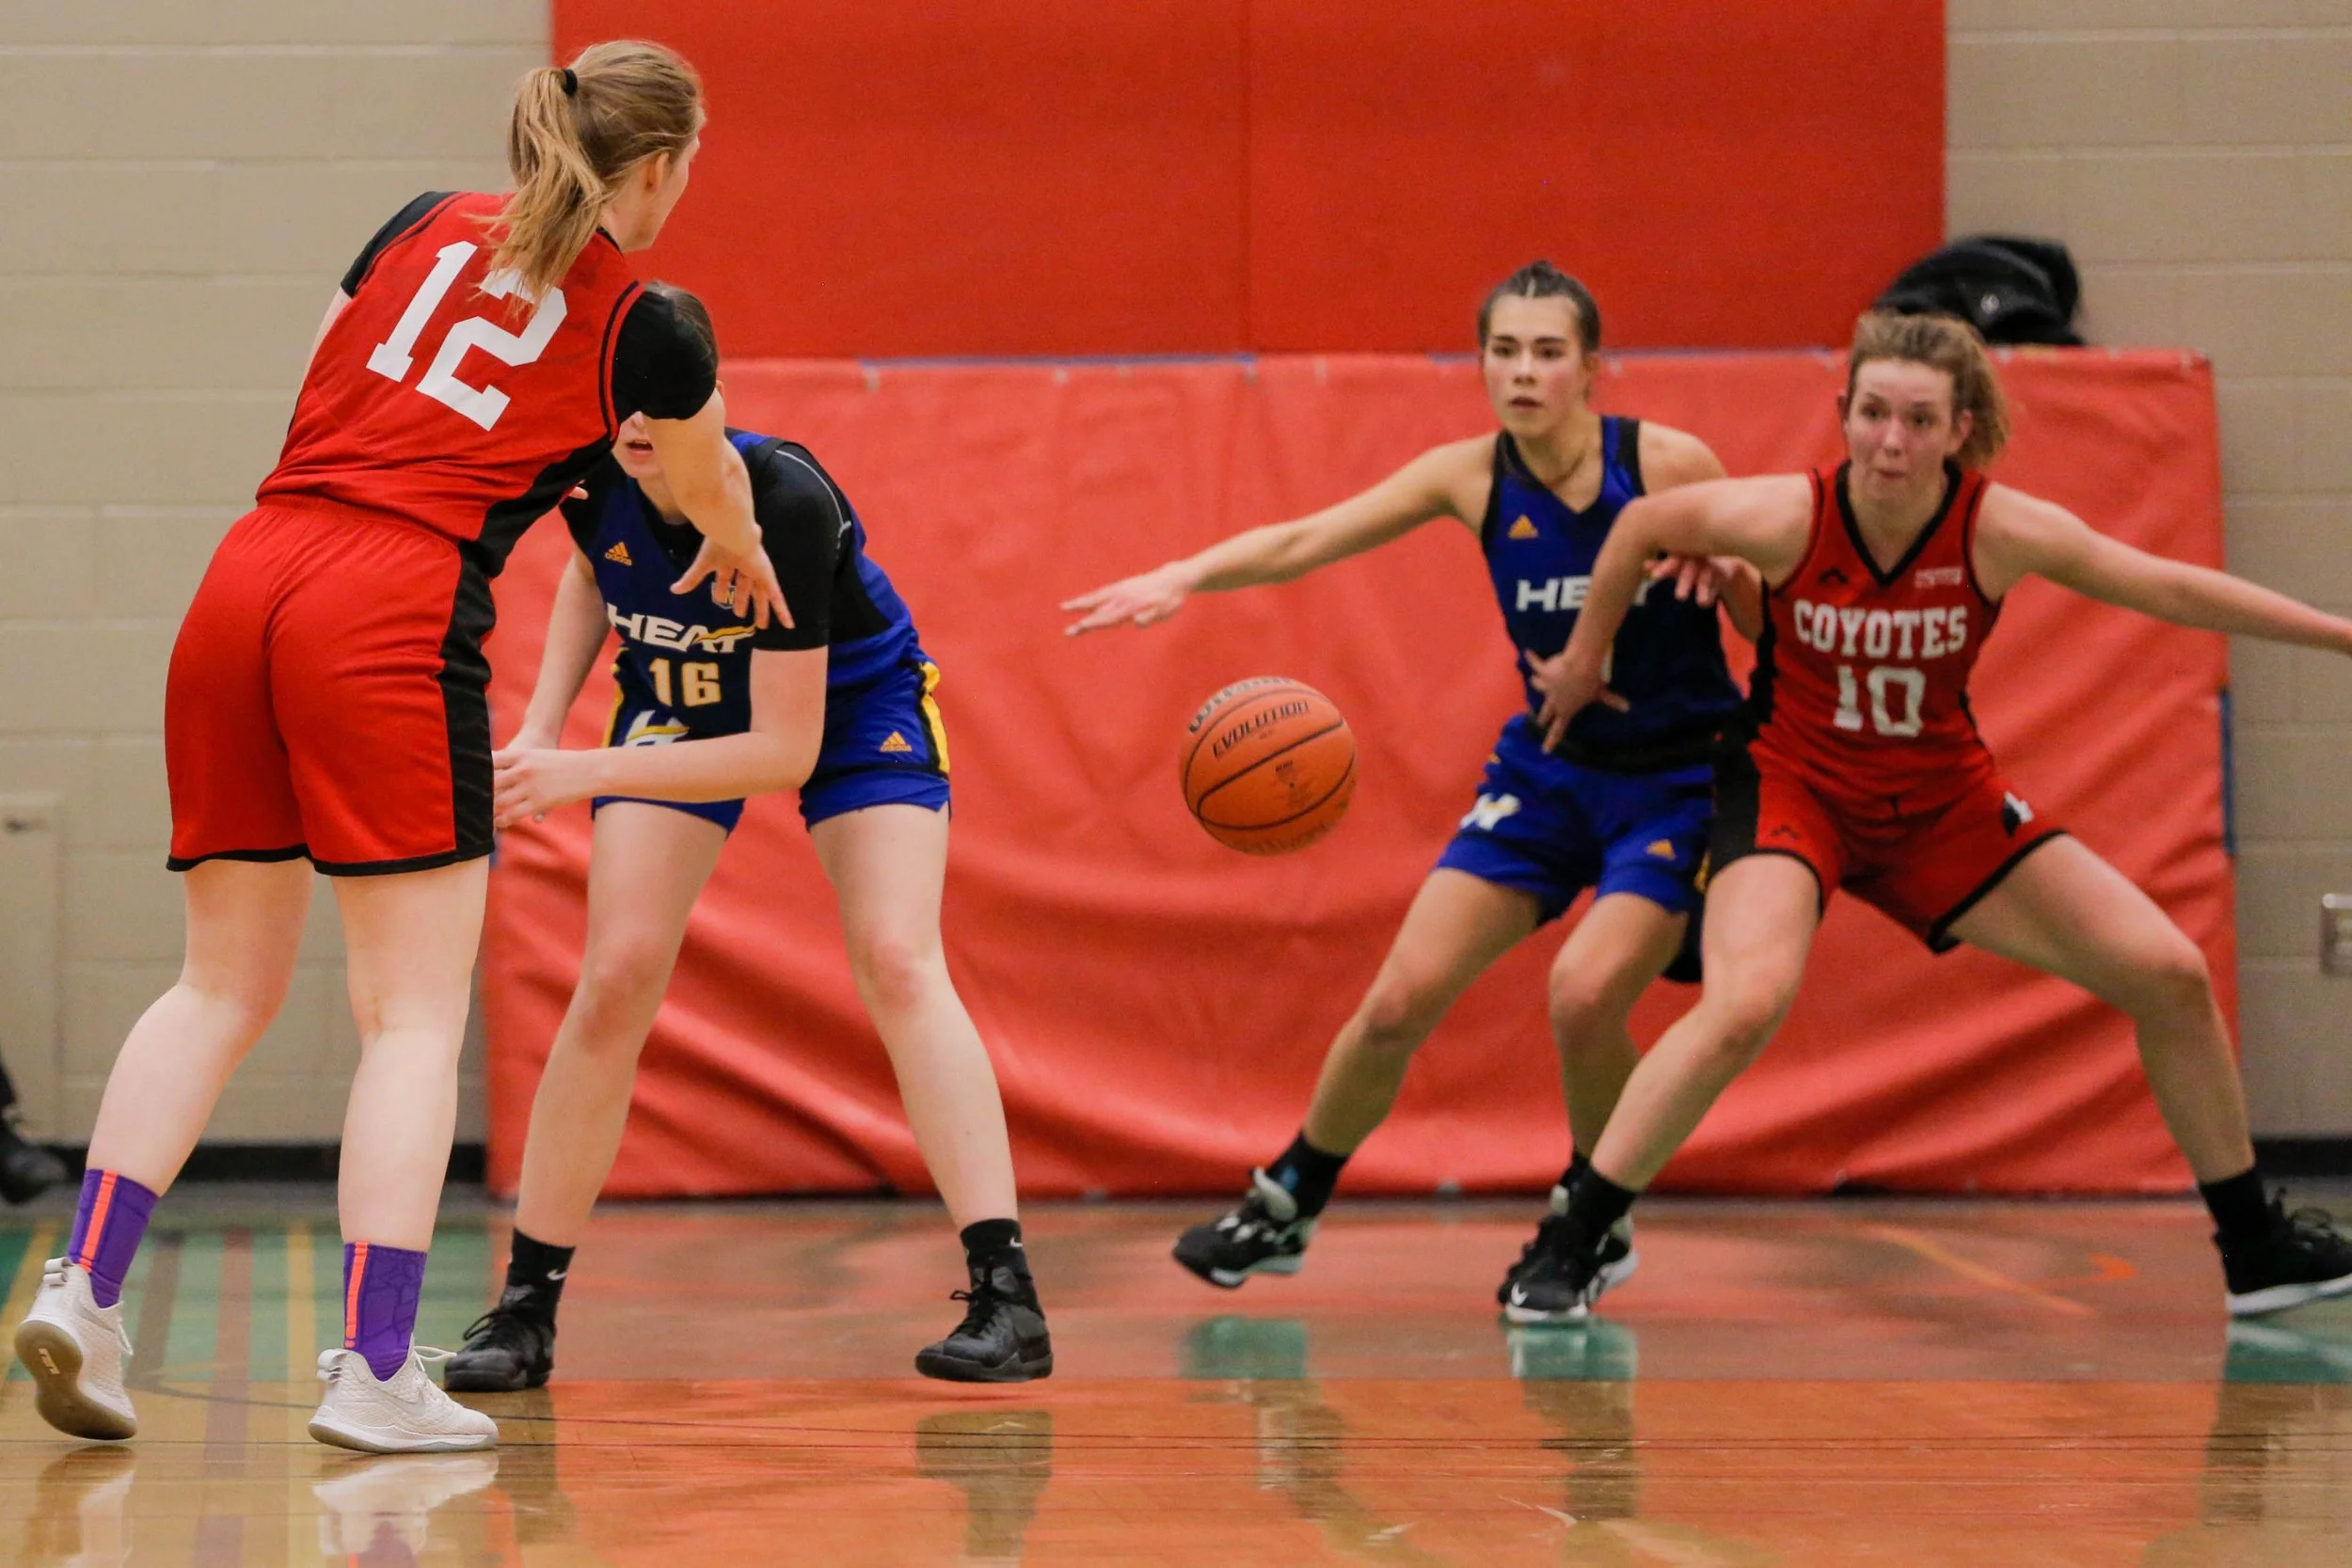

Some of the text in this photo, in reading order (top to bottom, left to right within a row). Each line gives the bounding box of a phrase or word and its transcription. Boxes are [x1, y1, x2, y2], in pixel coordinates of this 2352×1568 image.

[365, 240, 567, 432] 12
[607, 602, 755, 653] HEAT
[1794, 598, 1968, 659] COYOTES
[649, 658, 721, 707] 16
[1834, 664, 1927, 737] 10
[1213, 700, 1309, 758] EVOLUTION
